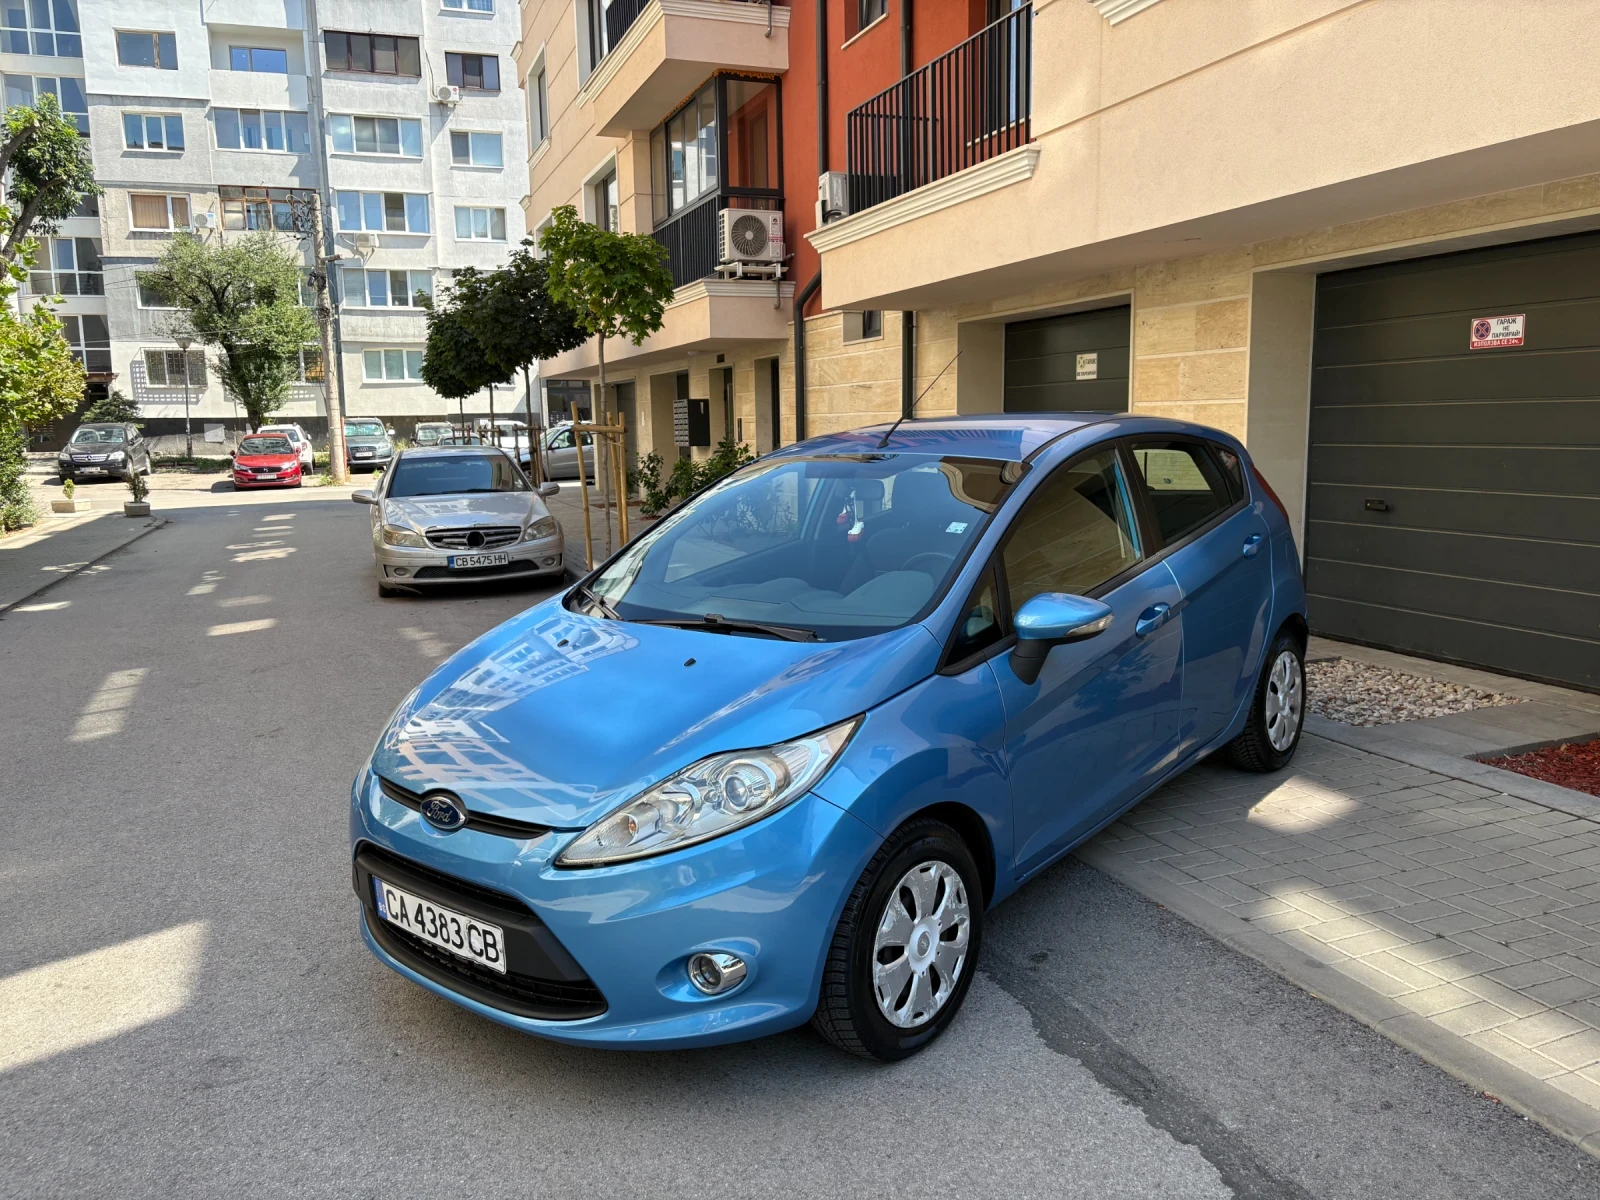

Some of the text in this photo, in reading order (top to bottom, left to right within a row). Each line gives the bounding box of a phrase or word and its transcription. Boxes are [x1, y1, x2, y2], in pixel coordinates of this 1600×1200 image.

[1497, 318, 1517, 326] ГАРАЖ
[1492, 330, 1520, 338] ПАРКИРАЙ!
[427, 801, 453, 822] Ford
